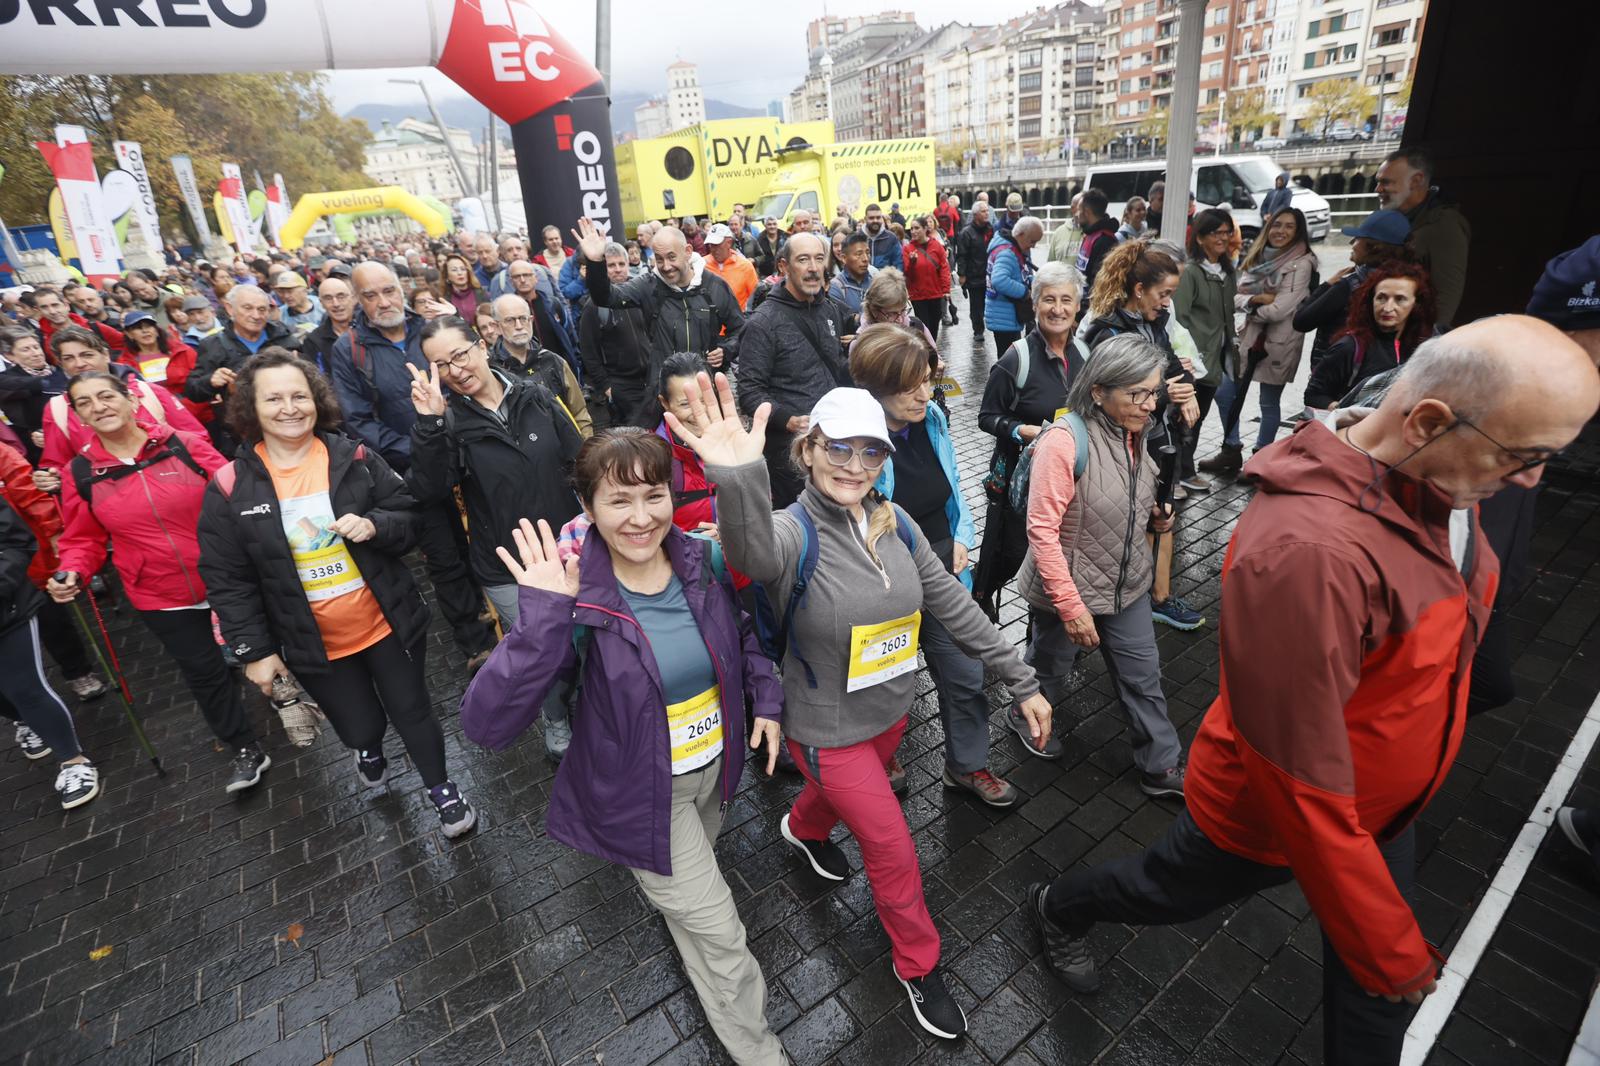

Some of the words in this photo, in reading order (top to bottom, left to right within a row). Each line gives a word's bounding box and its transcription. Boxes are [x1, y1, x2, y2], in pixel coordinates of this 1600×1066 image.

[488, 41, 561, 82] EC
[712, 135, 773, 167] DYA
[716, 166, 777, 180] www.dya.es
[834, 160, 861, 171] puesto
[877, 170, 921, 203] DYA
[322, 193, 384, 208] vueling
[310, 562, 343, 579] 3388
[881, 634, 907, 655] 2603
[687, 712, 720, 739] 2604
[685, 738, 709, 753] vueling
